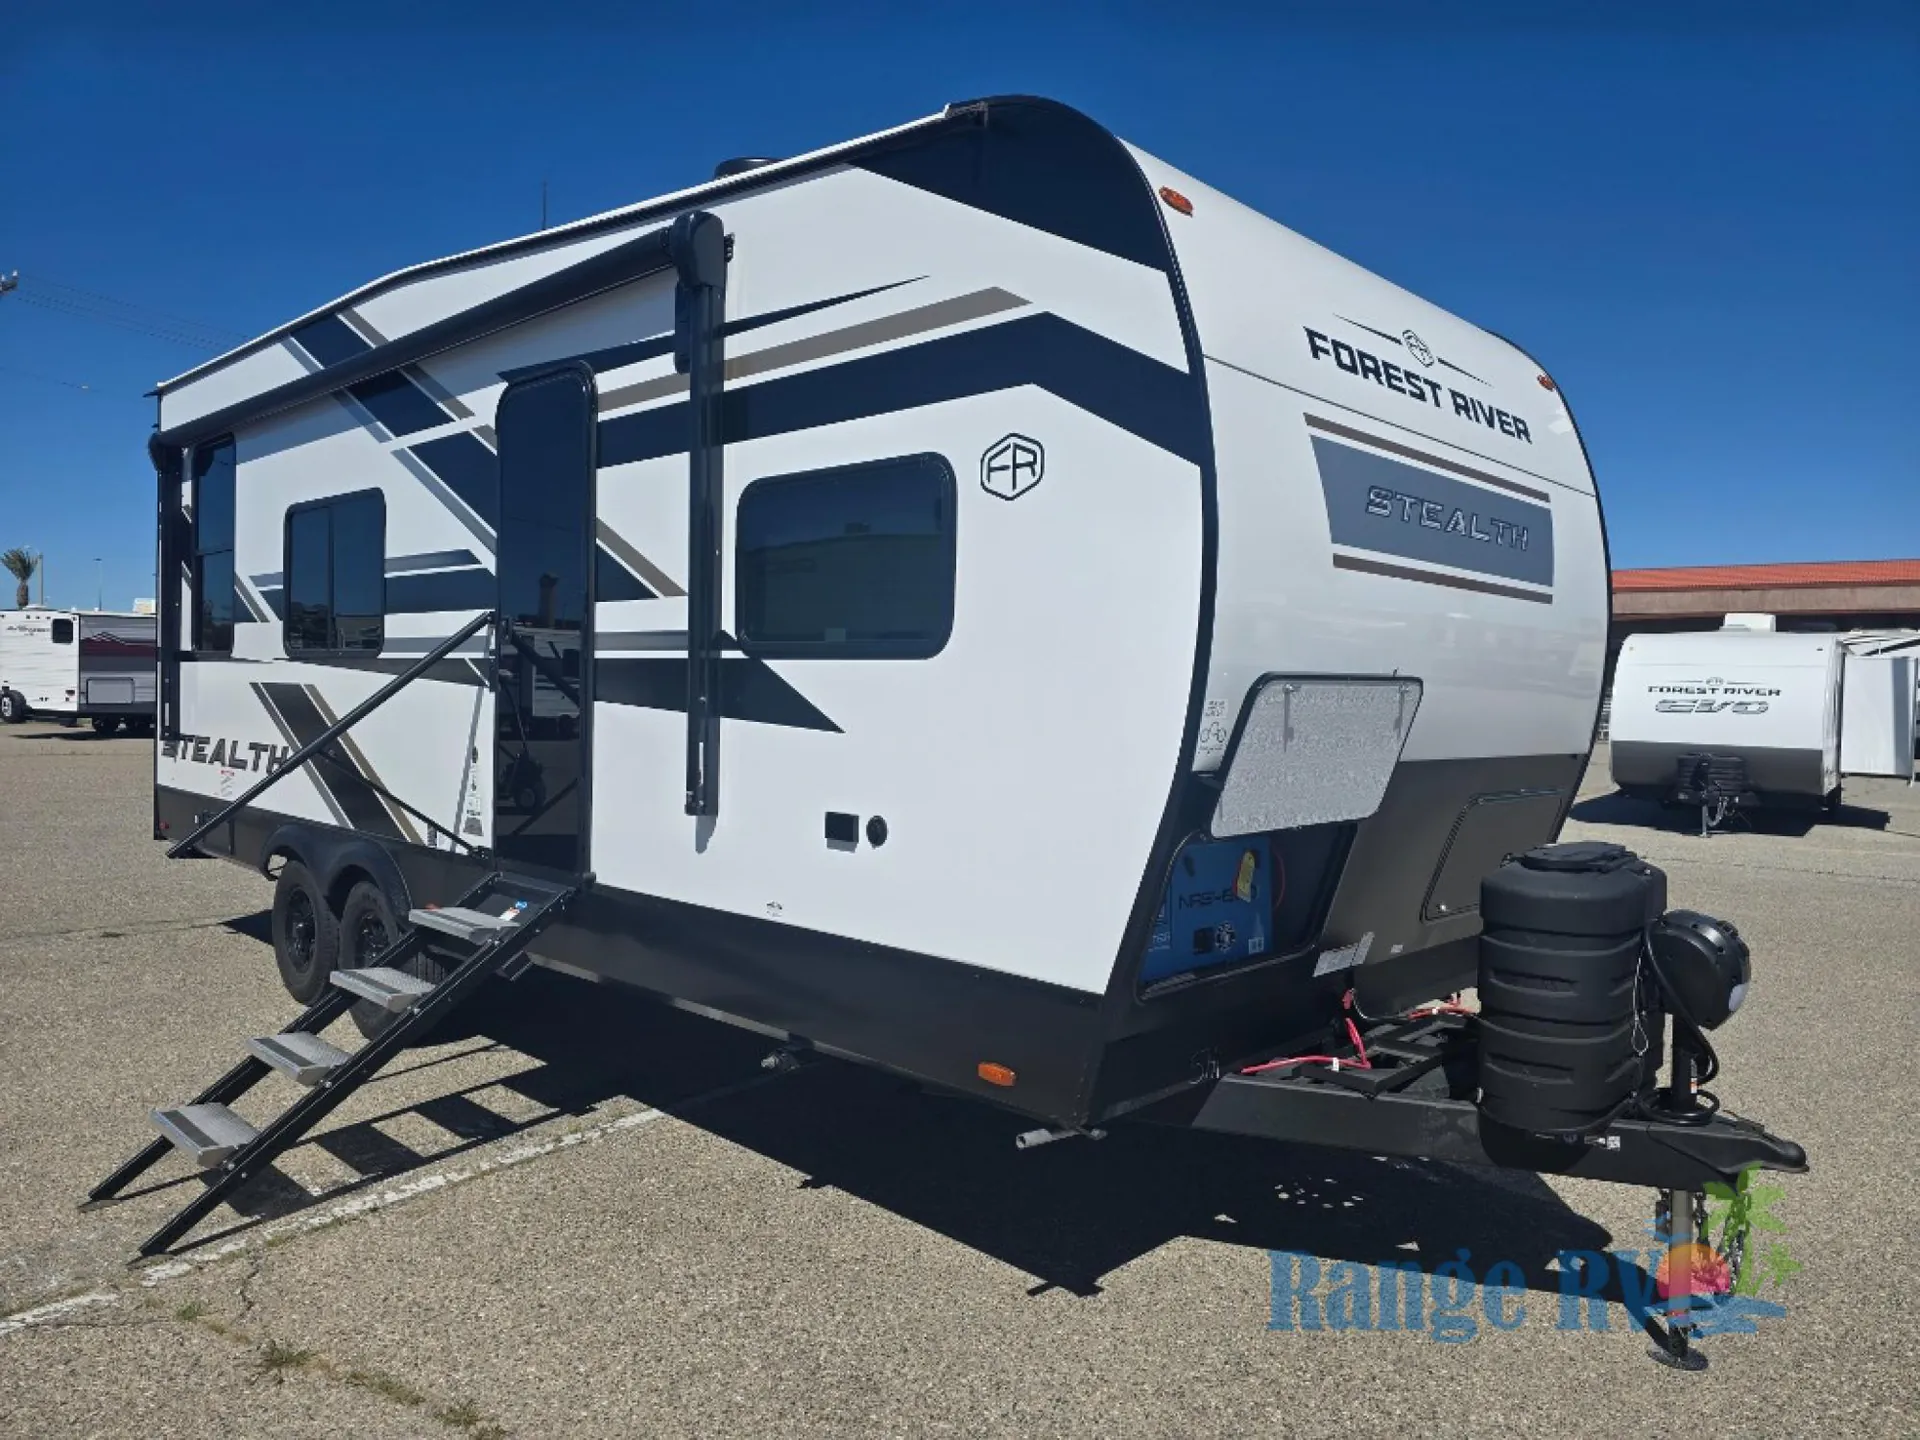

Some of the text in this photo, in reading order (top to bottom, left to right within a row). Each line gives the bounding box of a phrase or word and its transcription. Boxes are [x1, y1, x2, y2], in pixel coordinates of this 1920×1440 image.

[1303, 326, 1533, 445] FOREST RIVER
[984, 438, 1040, 495] FR
[1365, 485, 1529, 551] STEALTH
[1647, 686, 1782, 696] FOREST RIVER
[161, 734, 289, 774] STEALTH
